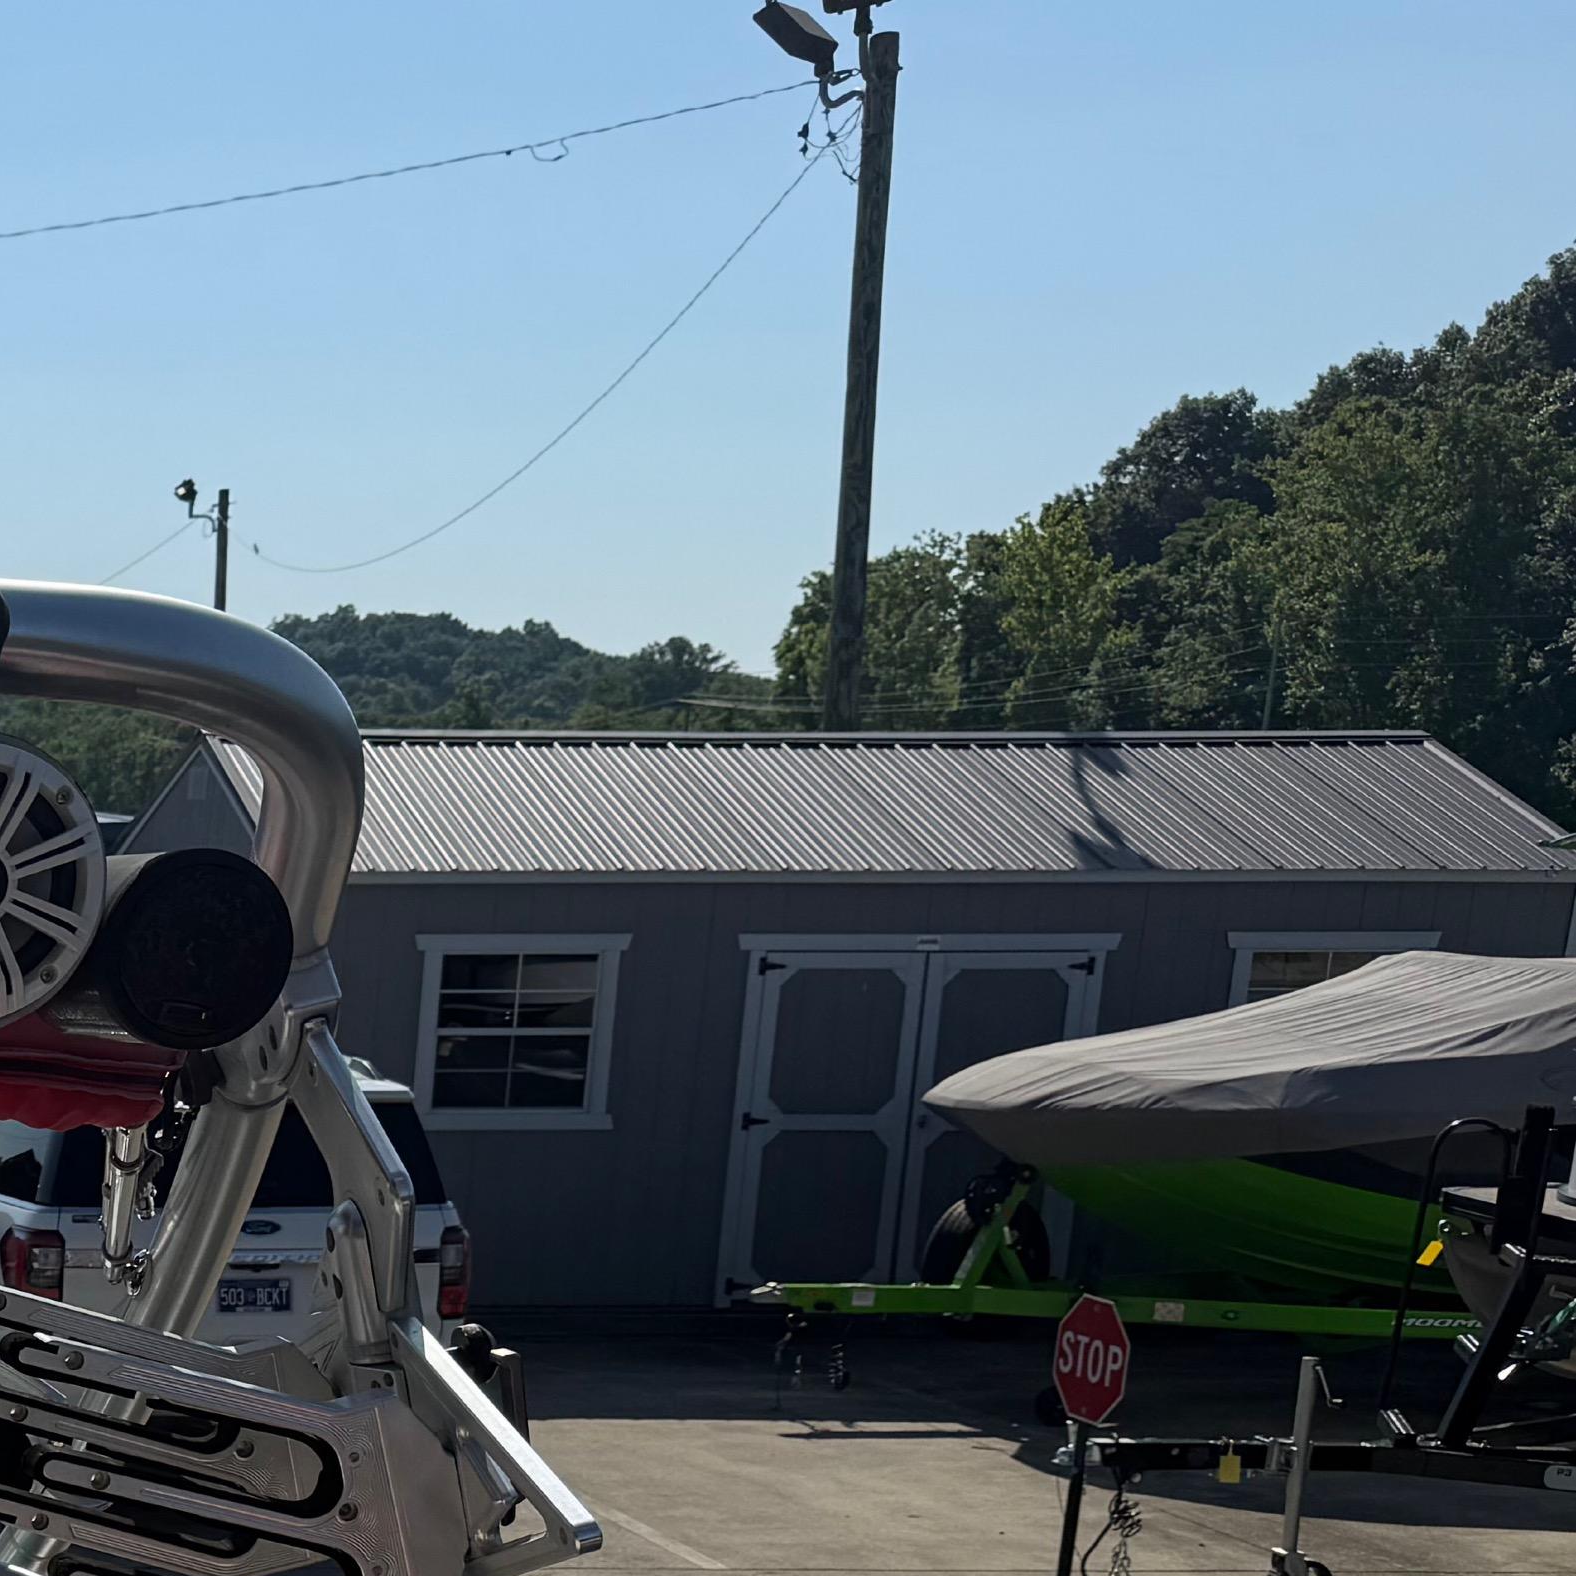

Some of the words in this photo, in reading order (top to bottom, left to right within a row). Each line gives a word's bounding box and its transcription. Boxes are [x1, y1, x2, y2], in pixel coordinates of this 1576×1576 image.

[220, 1288, 244, 1305] 503
[256, 1288, 287, 1305] BCKT
[1059, 1330, 1123, 1387] STOP
